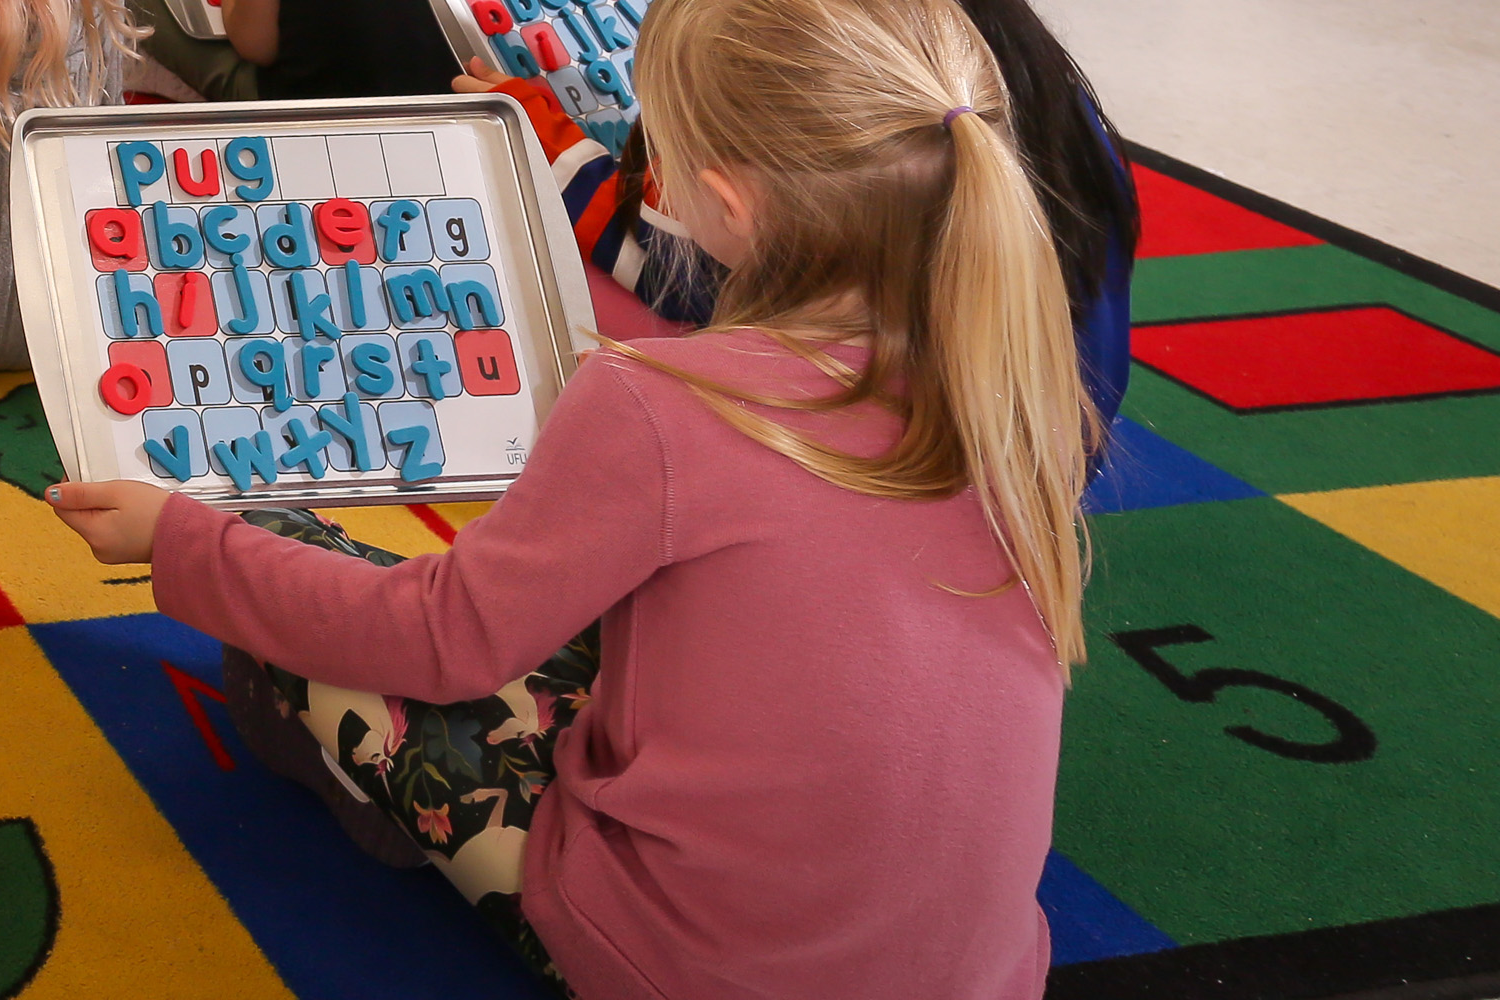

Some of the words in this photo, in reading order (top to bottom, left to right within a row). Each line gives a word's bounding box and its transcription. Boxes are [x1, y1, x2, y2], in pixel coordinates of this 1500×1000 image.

[116, 136, 275, 207] pug
[89, 209, 140, 260] a
[153, 200, 200, 269] b
[203, 205, 251, 255] c
[262, 202, 311, 269] d
[318, 198, 366, 247] e
[377, 200, 420, 262] f
[445, 215, 469, 257] g
[115, 269, 165, 338] h
[179, 271, 198, 329] i
[228, 254, 259, 334] j
[289, 272, 342, 340] k
[387, 268, 450, 323] m
[446, 279, 501, 331] n
[101, 363, 152, 415] o
[188, 361, 209, 405] p
[239, 340, 294, 411] q
[299, 344, 335, 399] r
[351, 343, 395, 396] s
[411, 339, 452, 400] t
[476, 354, 499, 381] u
[144, 425, 193, 482] v
[213, 430, 279, 492] w
[281, 418, 332, 479] x
[319, 391, 373, 472] y
[387, 425, 443, 483] z
[1102, 623, 1379, 765] 5
